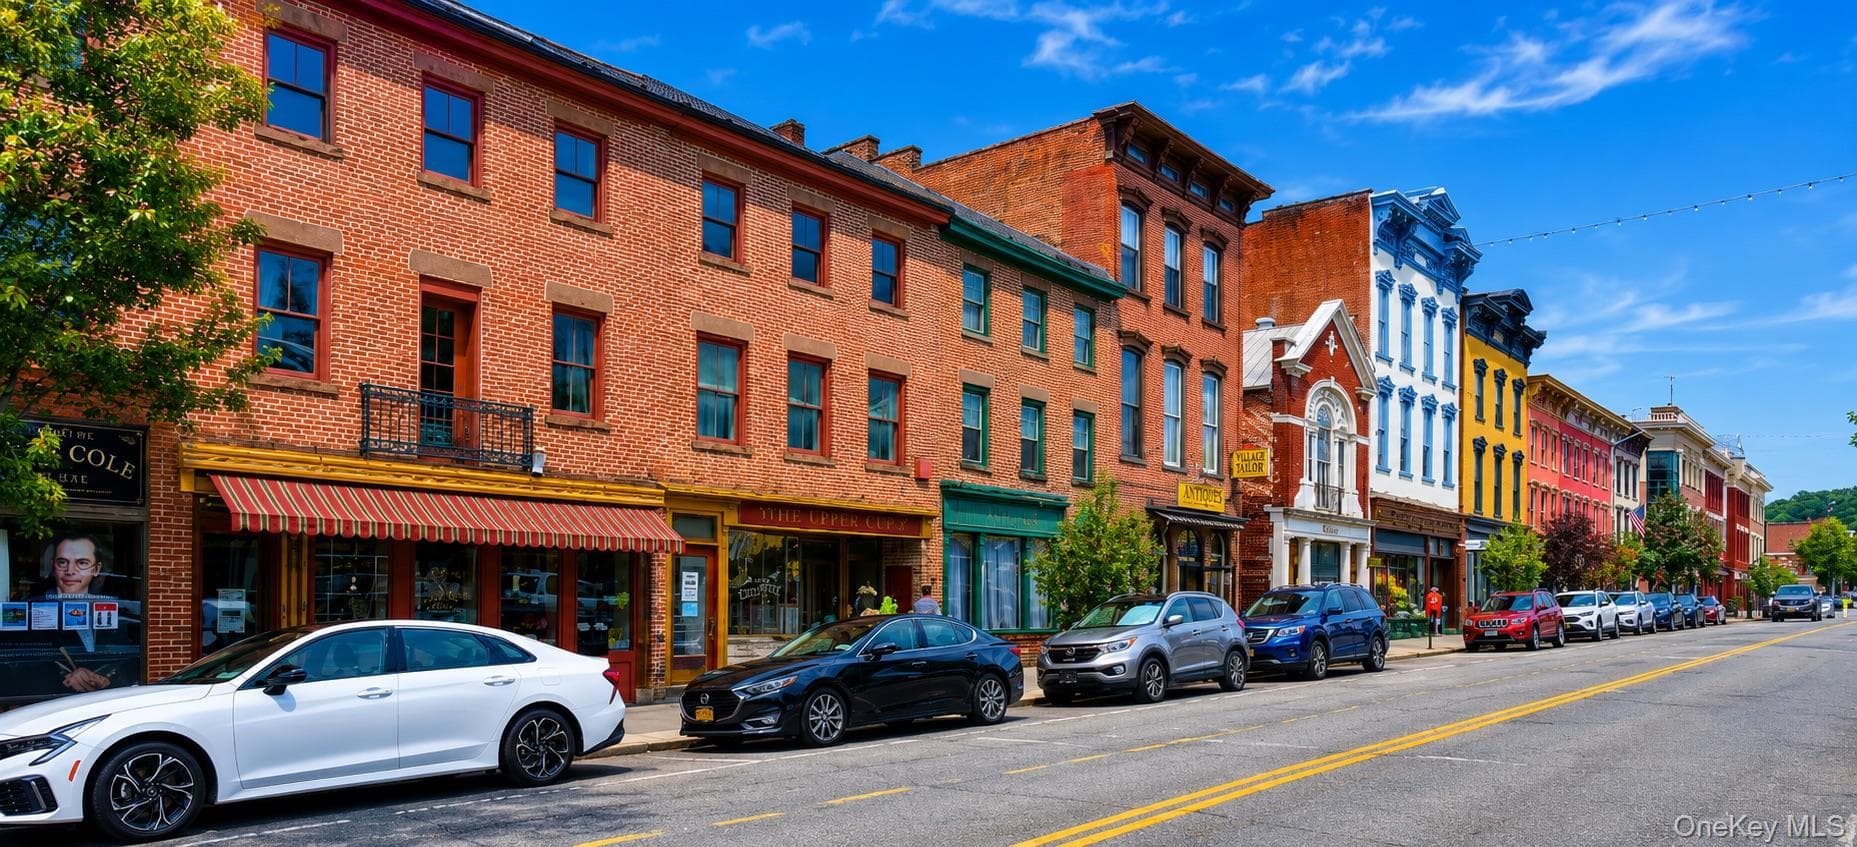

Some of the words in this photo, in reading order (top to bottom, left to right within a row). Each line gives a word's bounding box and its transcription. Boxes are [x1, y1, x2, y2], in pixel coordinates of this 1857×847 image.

[69, 445, 136, 480] COLE
[1235, 452, 1265, 462] VILLAGE
[1235, 462, 1264, 473] TAILOR
[1183, 485, 1223, 504] ANTIQUES
[808, 510, 858, 527] UPPER
